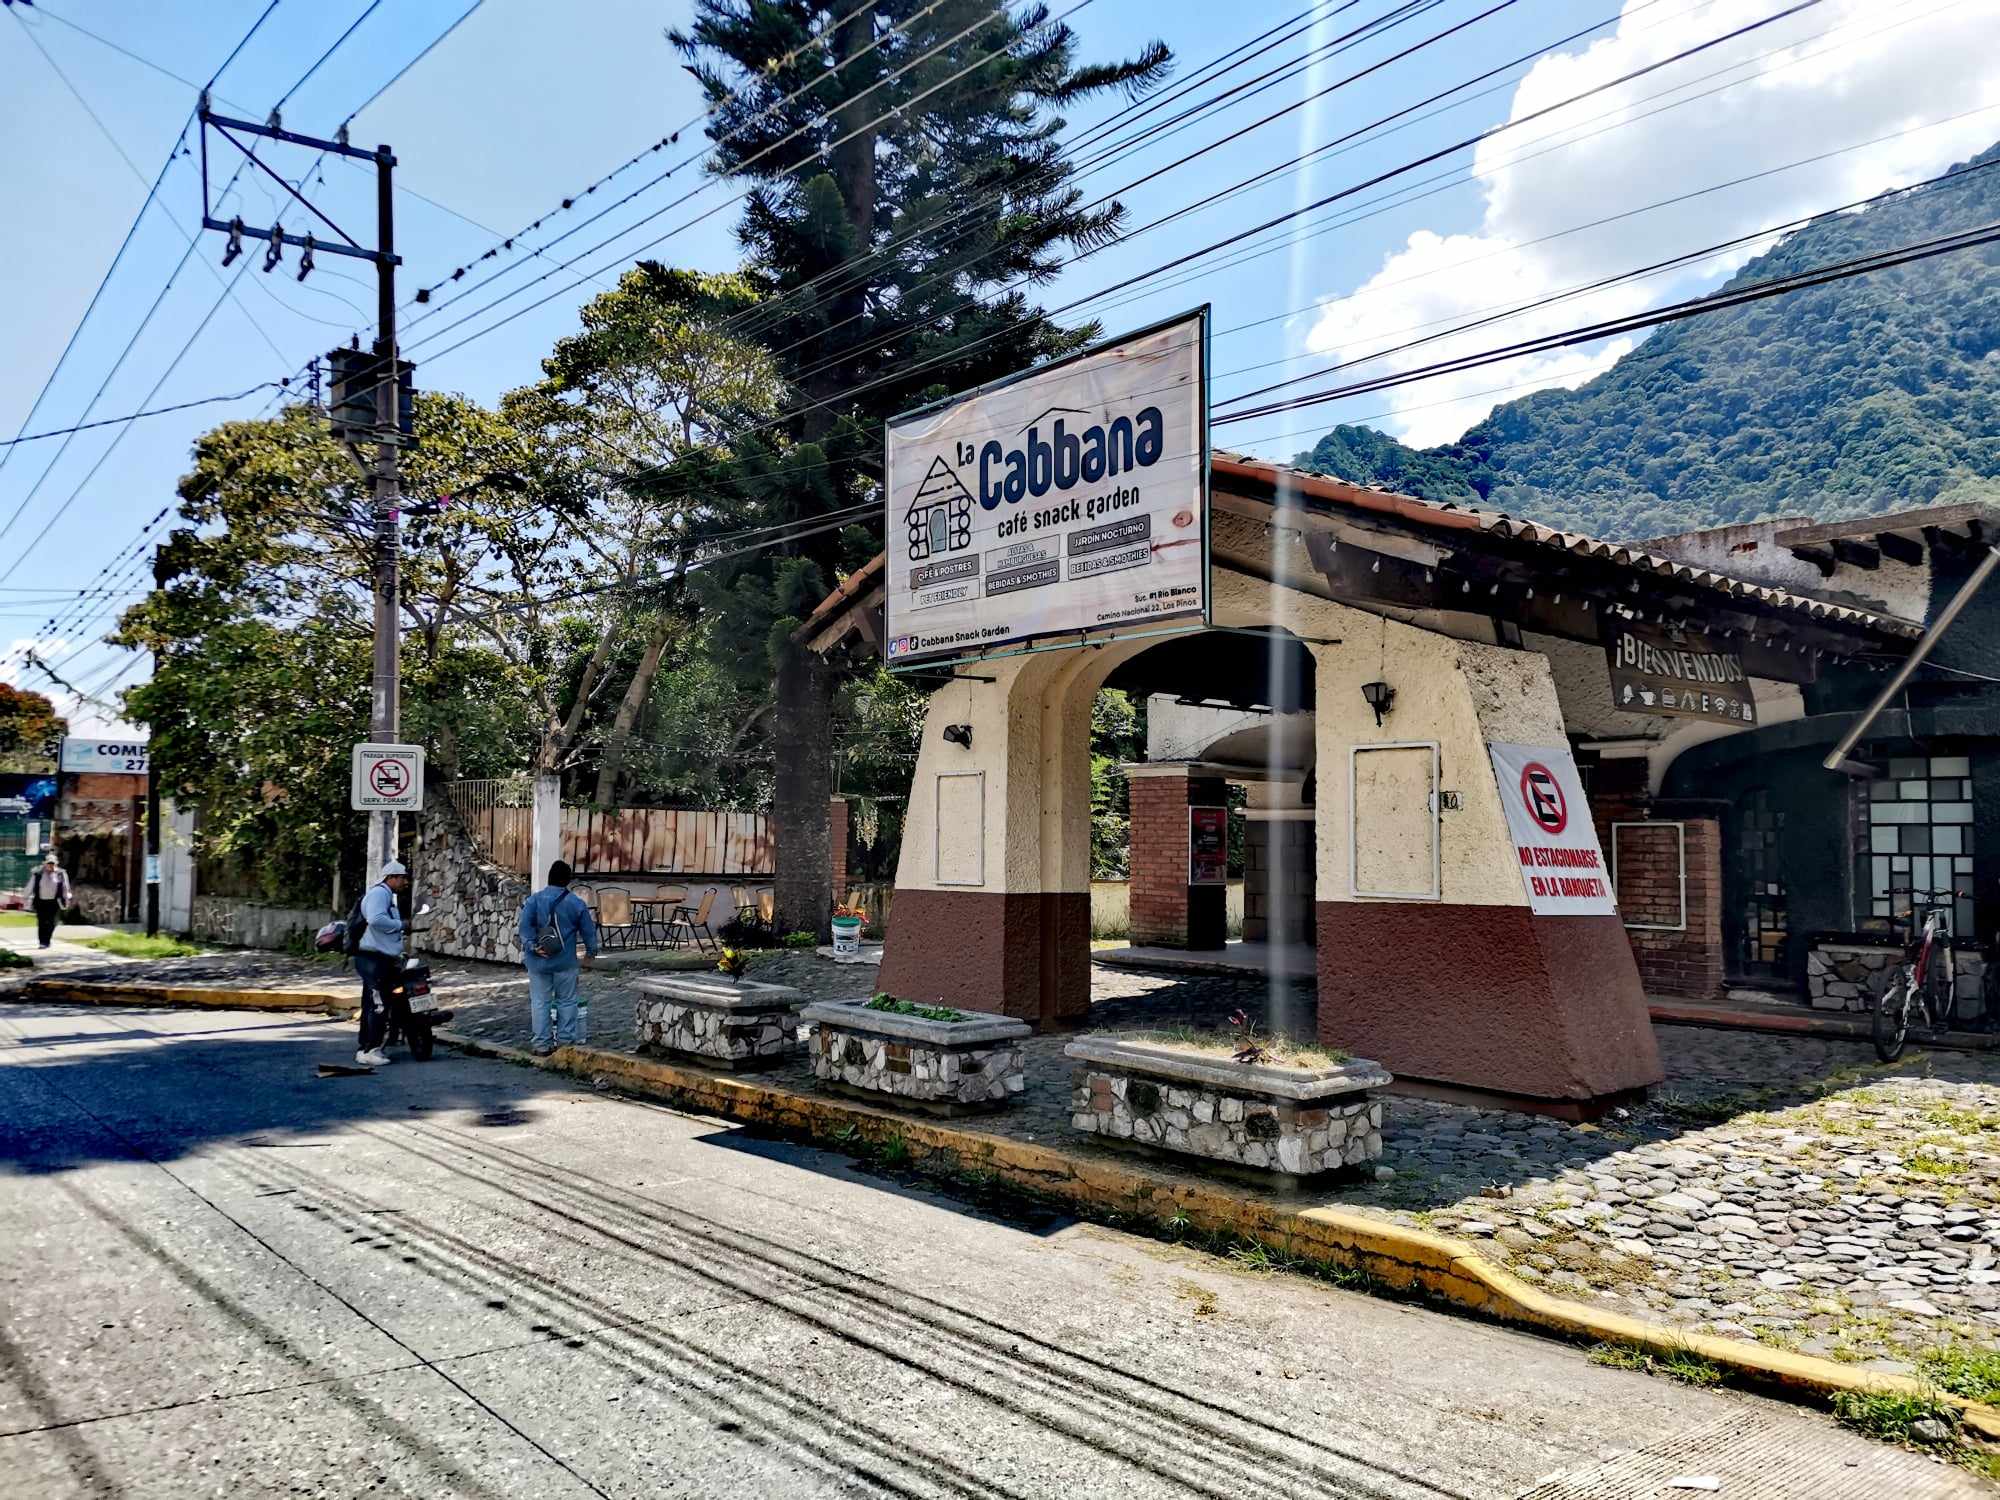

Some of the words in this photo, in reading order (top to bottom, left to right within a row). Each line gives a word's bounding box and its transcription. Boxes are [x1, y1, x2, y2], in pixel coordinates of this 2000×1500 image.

[957, 441, 975, 467] La
[979, 406, 1164, 511] Cabbana
[998, 510, 1028, 538] café
[1033, 498, 1080, 530] snack
[1086, 486, 1140, 521] garden
[1101, 522, 1145, 541] NOCTURNO
[1102, 557, 1109, 568] &
[1109, 548, 1149, 565] SMOTHIES
[917, 567, 934, 582] CFÉ
[940, 561, 973, 576] POSTRES
[988, 577, 1016, 591] BEBIDAS
[1016, 576, 1021, 585] &
[1022, 567, 1057, 583] SMOTHIES
[1170, 586, 1197, 597] Blanco
[1097, 611, 1121, 621] Camino
[1121, 605, 1150, 617] Nacional
[1162, 601, 1175, 611] Los
[920, 635, 954, 648] Cabbana
[954, 630, 980, 642] Snack
[981, 625, 1010, 638] Garden
[1517, 846, 1534, 867] NO
[1532, 847, 1601, 869] ESTACIONARSE
[1530, 876, 1547, 897] EN
[1545, 877, 1560, 897] LA
[1558, 877, 1608, 900] BANQUETA
